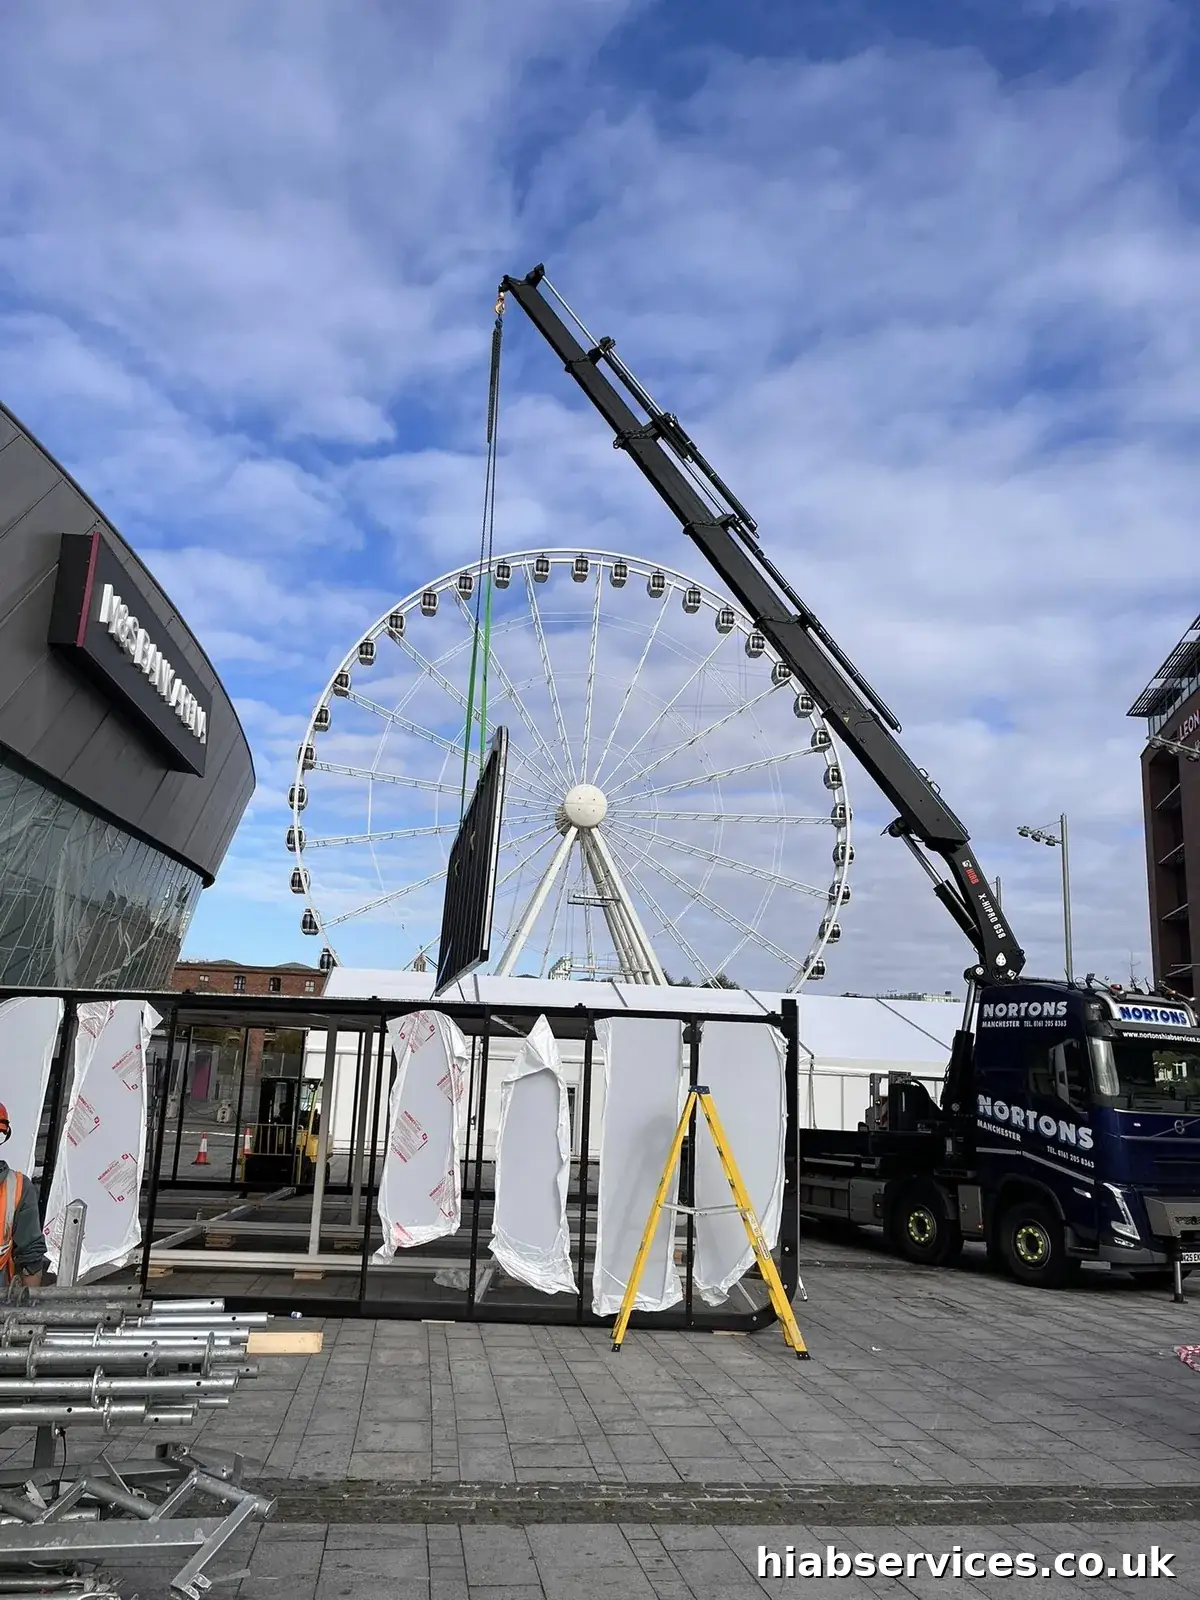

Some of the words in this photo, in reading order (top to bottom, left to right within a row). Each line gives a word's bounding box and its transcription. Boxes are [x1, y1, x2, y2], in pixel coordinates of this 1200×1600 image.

[966, 868, 979, 885] HIAB
[978, 893, 999, 923] X-HIPRO
[983, 1001, 1067, 1017] NORTONS
[1120, 1006, 1187, 1025] NORTONS
[977, 1094, 1094, 1149] NORTONS
[977, 1119, 1021, 1142] MANCHESTER
[1046, 1145, 1057, 1155] TEL.
